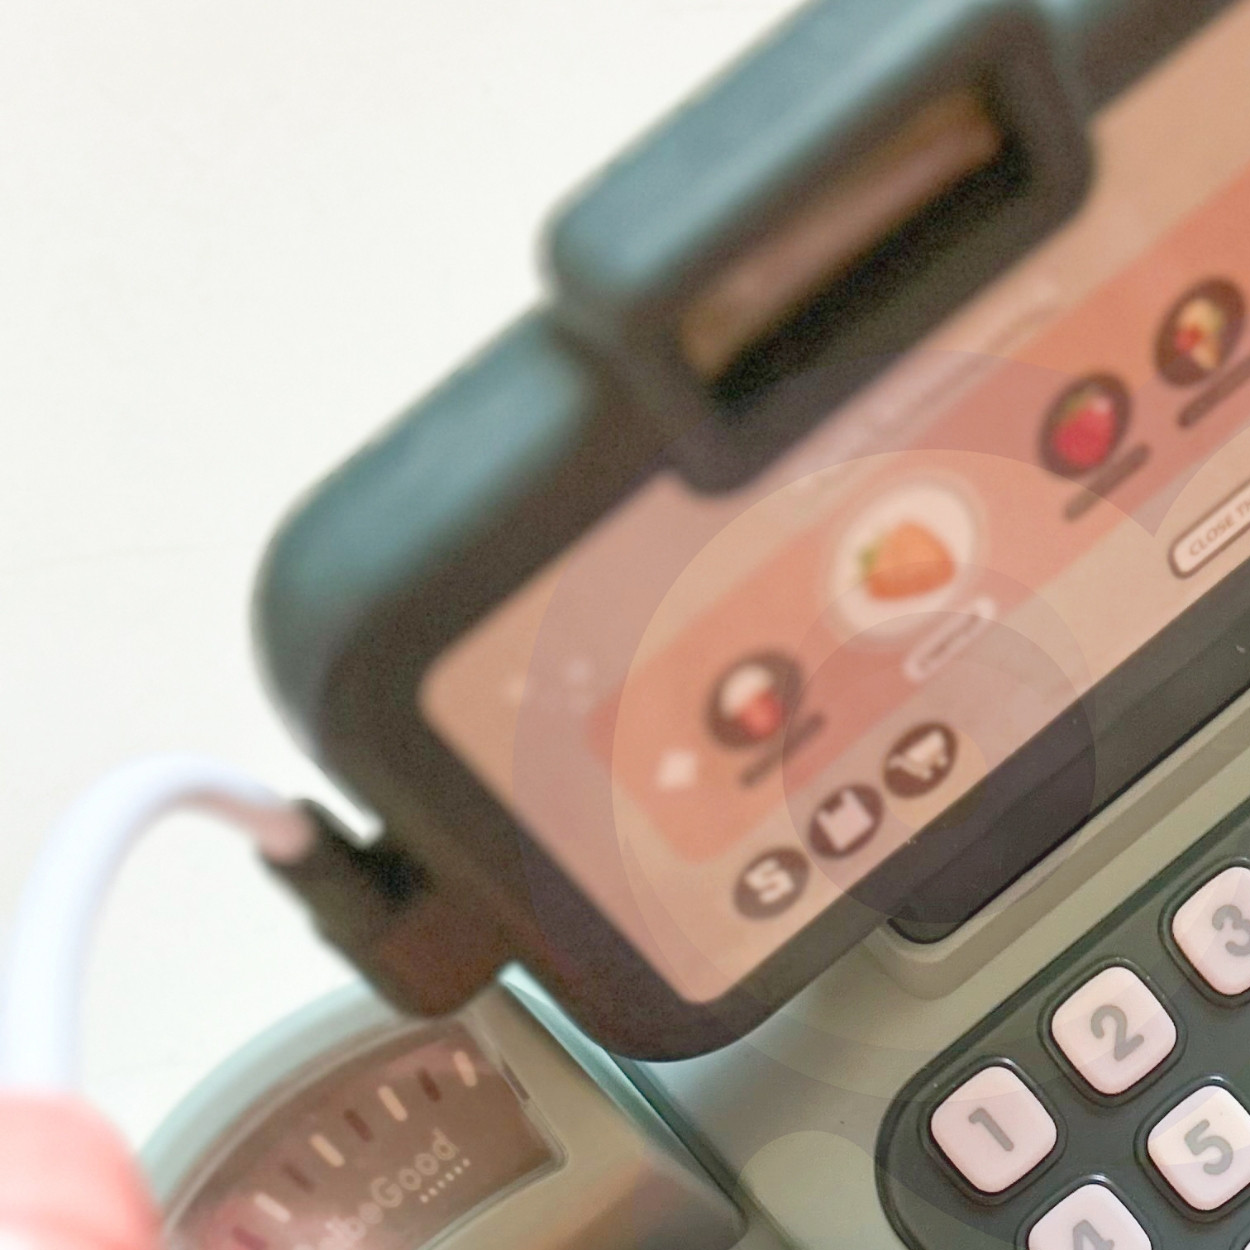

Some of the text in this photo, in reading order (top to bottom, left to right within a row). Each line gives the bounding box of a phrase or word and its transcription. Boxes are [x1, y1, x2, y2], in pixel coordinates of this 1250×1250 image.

[1188, 516, 1235, 557] CLOSE
[1089, 1003, 1146, 1063] 2
[967, 1105, 1015, 1153] 1
[1183, 1118, 1235, 1178] 5
